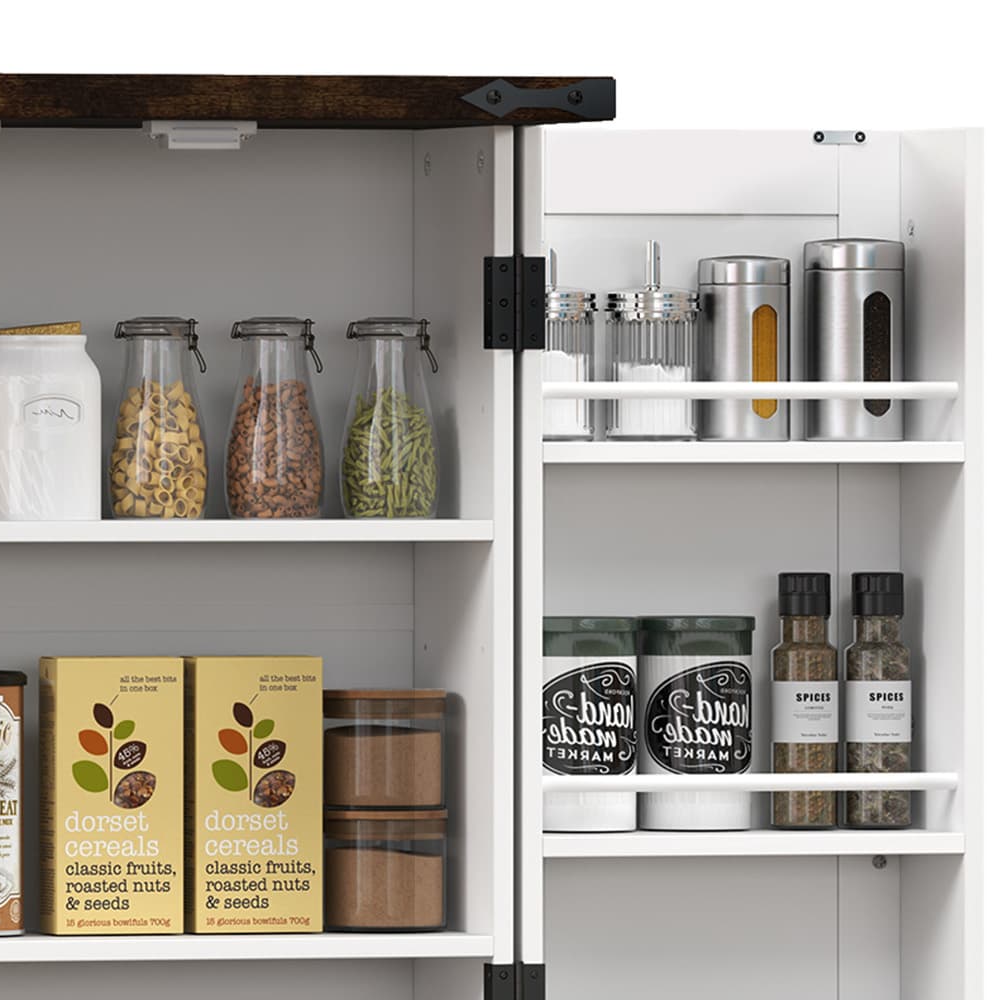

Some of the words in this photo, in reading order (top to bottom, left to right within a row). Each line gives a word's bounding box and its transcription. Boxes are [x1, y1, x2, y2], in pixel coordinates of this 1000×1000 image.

[120, 675, 130, 683] all
[131, 675, 144, 683] the
[145, 675, 161, 683] best
[163, 675, 177, 683] bits
[259, 674, 269, 682] all
[271, 674, 283, 682] the
[285, 674, 300, 682] best
[302, 674, 316, 682] bits
[796, 692, 831, 702] SPICES
[869, 692, 904, 702] SPICES
[64, 811, 149, 832] dorset
[204, 809, 289, 831] dorset
[64, 836, 159, 857] cereals
[204, 834, 299, 856] cereals
[65, 862, 122, 876] classic
[126, 861, 177, 877] fruits,
[205, 861, 261, 875] classic
[265, 859, 316, 876] fruits,
[65, 879, 128, 893] roasted
[133, 879, 171, 893] nuts
[205, 878, 268, 892] roasted
[272, 878, 310, 891] nuts
[66, 896, 80, 910] &
[84, 896, 130, 910] seeds
[205, 895, 220, 909] &
[224, 895, 269, 909] seeds
[77, 919, 111, 928] glorious
[112, 918, 148, 926] bowlfuls
[150, 918, 171, 927] 700g
[217, 917, 250, 926] glorious
[253, 916, 287, 925] bowlfuls
[289, 917, 310, 926] 700g
